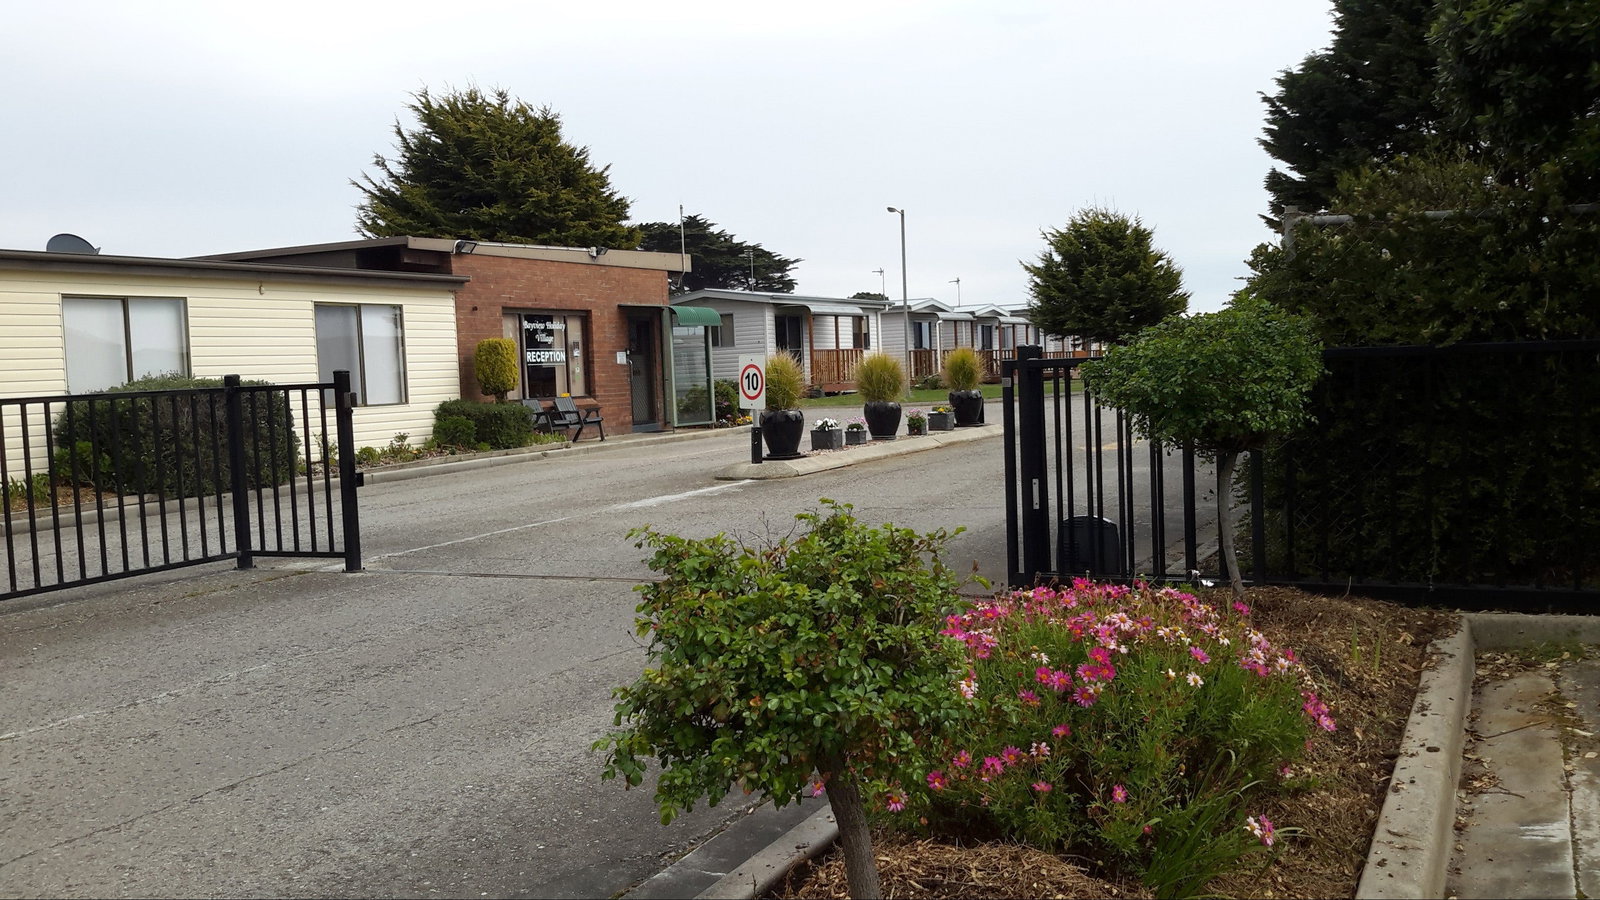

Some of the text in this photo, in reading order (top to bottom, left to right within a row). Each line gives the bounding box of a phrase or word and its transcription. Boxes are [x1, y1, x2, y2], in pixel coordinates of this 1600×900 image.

[523, 320, 565, 332] Bayview Holiday
[526, 351, 566, 362] RECEPTION
[745, 373, 758, 391] 10
